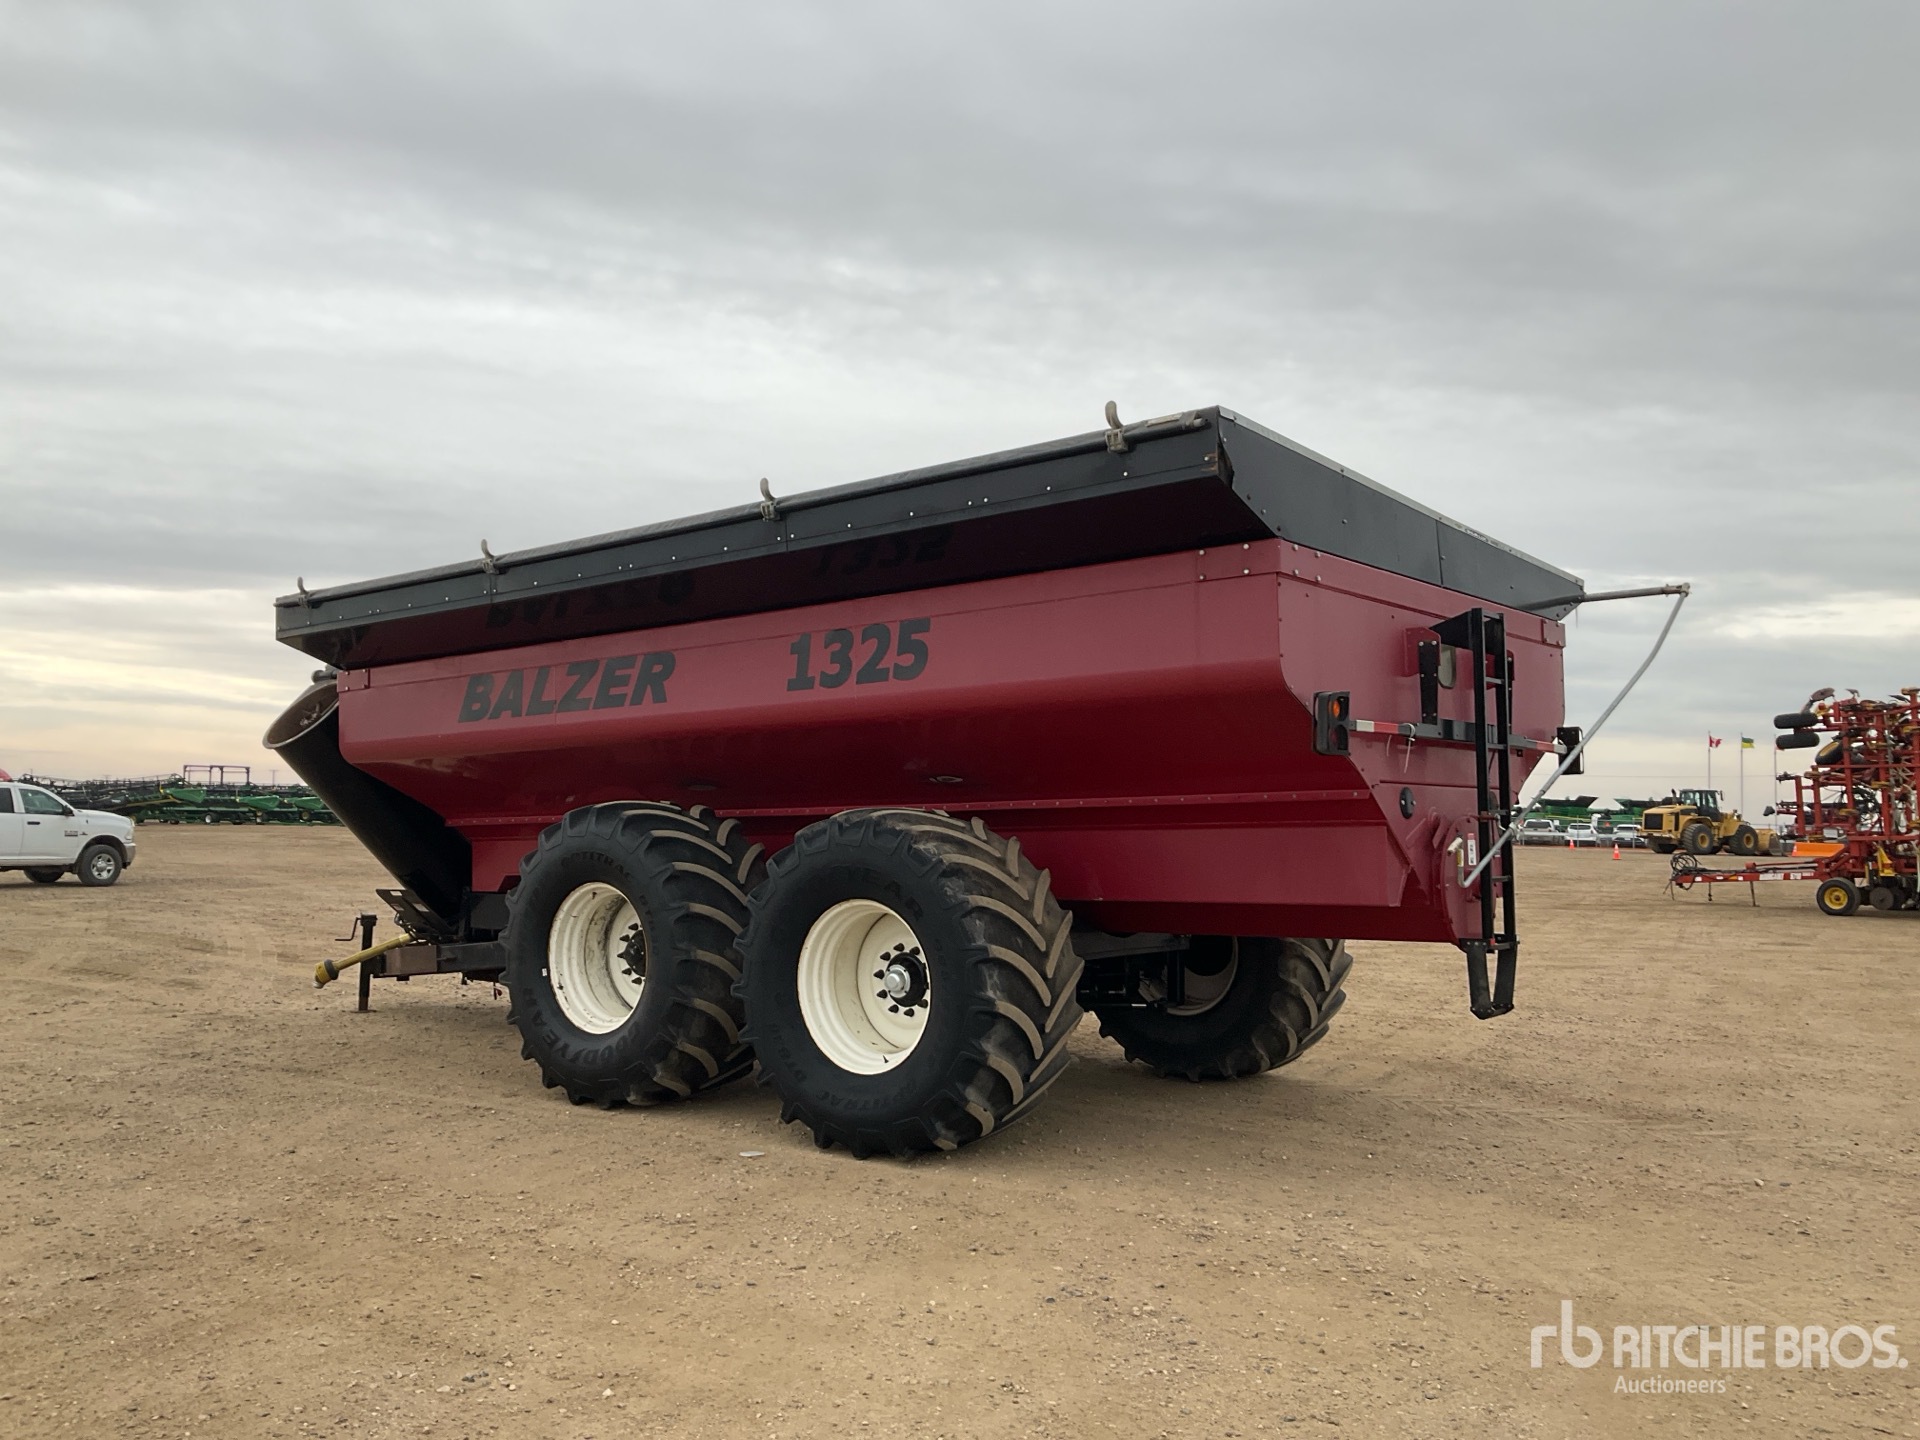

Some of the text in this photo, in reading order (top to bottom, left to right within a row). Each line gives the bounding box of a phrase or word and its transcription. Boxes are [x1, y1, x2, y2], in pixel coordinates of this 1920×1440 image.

[459, 652, 676, 723] BALZER
[786, 618, 931, 691] 1325
[522, 987, 639, 1064] GOODYEAR
